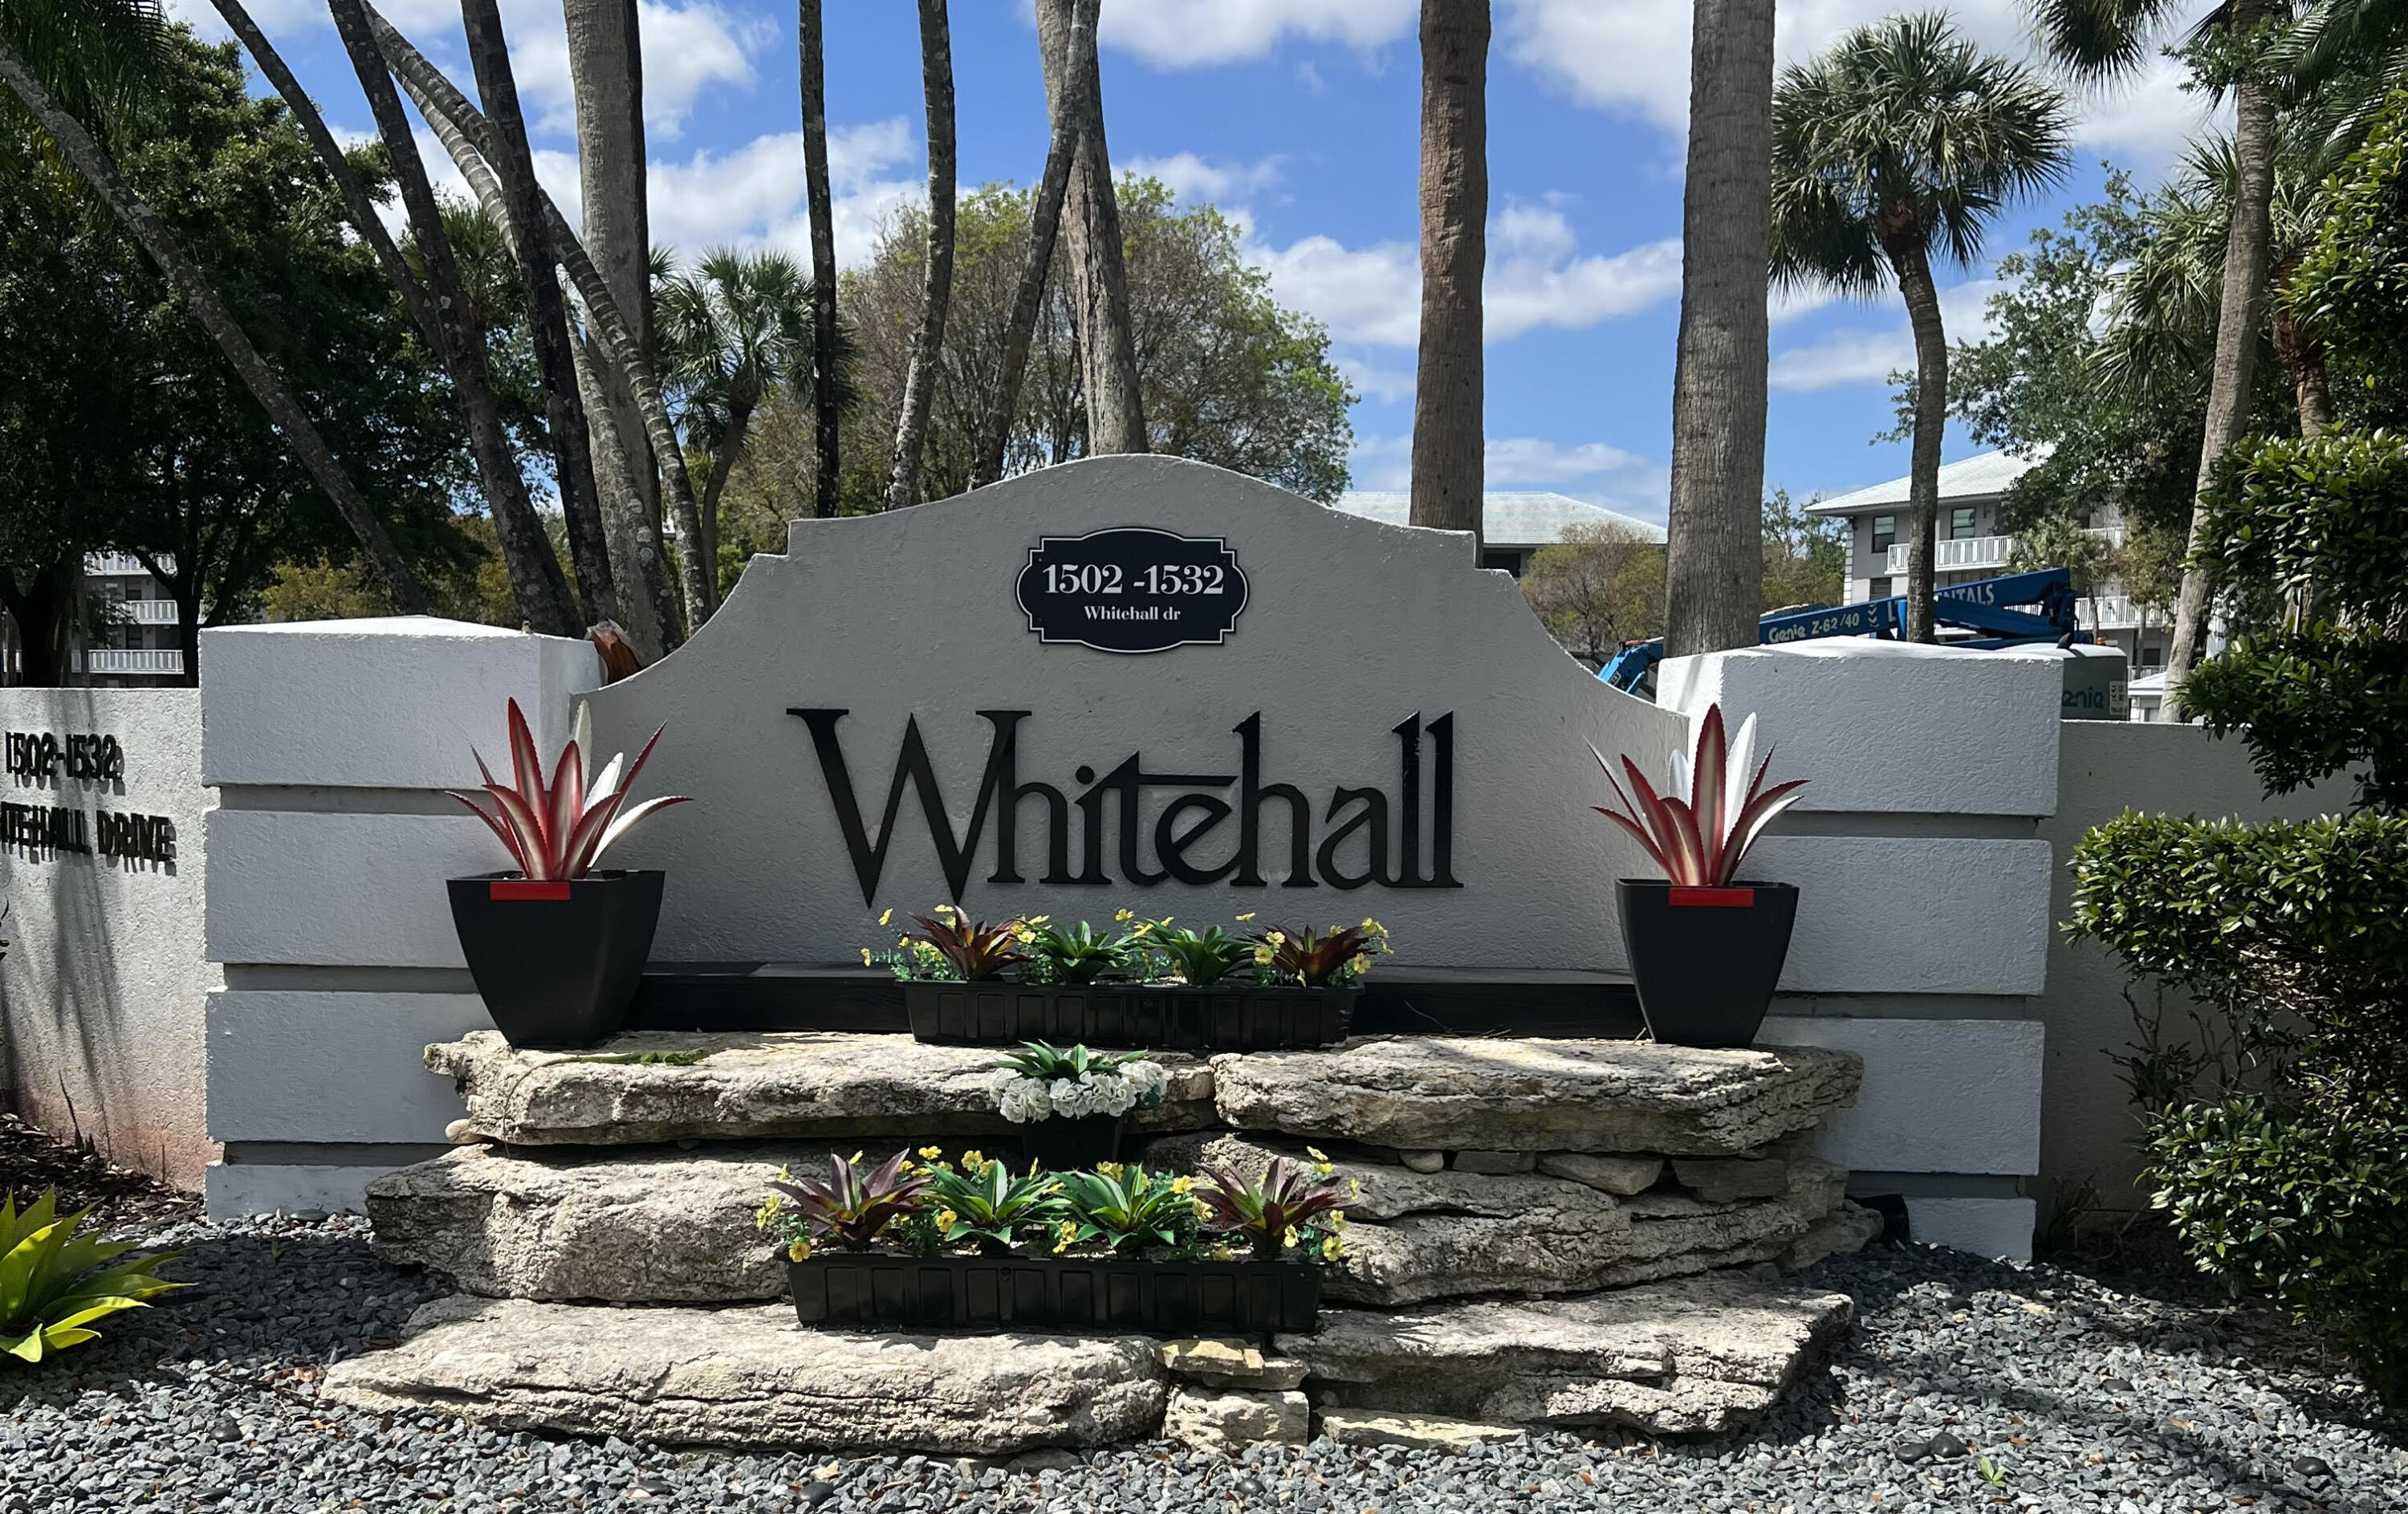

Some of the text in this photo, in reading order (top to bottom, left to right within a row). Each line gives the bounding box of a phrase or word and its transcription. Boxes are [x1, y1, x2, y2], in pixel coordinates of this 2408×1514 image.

[1043, 564, 1123, 594] 1502
[1084, 606, 1181, 621] Whitehall dr
[1768, 623, 1806, 643] Genie
[2062, 686, 2104, 709] enie
[6, 732, 119, 779] 1502-1532
[786, 708, 1465, 910] Whitehall
[0, 801, 172, 862] ITEHALL DRIVE
